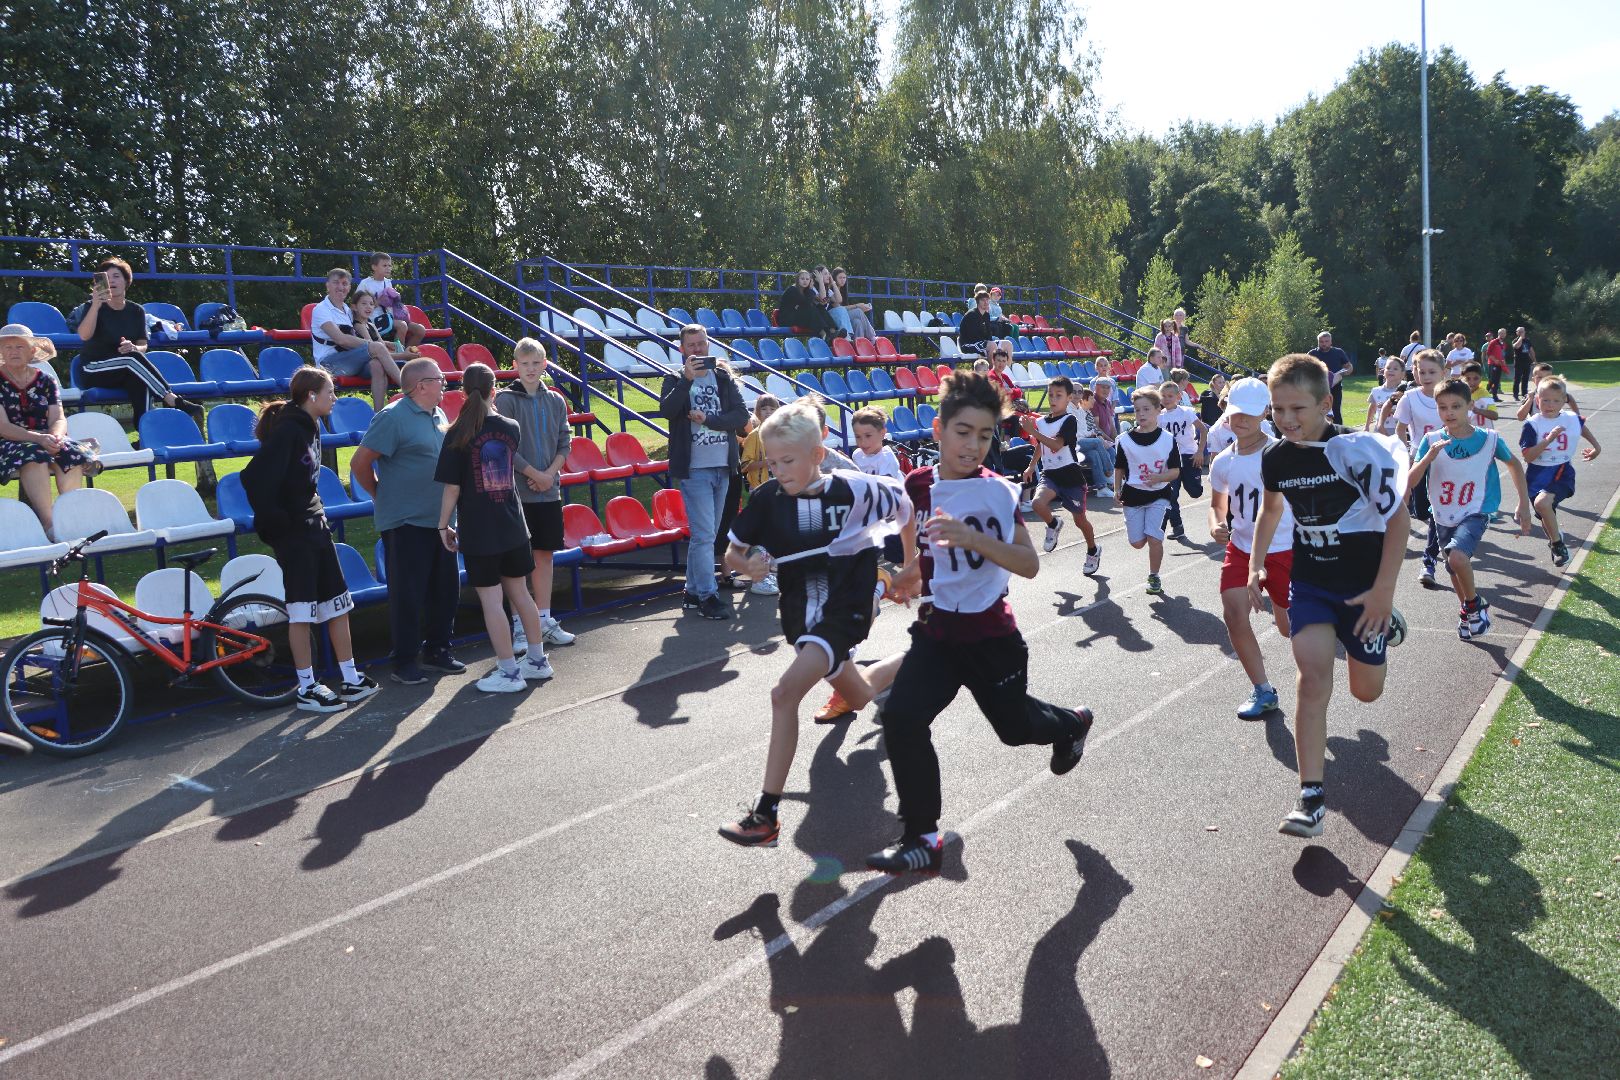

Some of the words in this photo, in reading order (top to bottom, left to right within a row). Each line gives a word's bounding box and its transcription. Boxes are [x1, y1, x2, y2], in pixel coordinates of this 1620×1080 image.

[1234, 482, 1260, 523] 11
[1438, 480, 1476, 507] 30
[825, 504, 851, 532] 17
